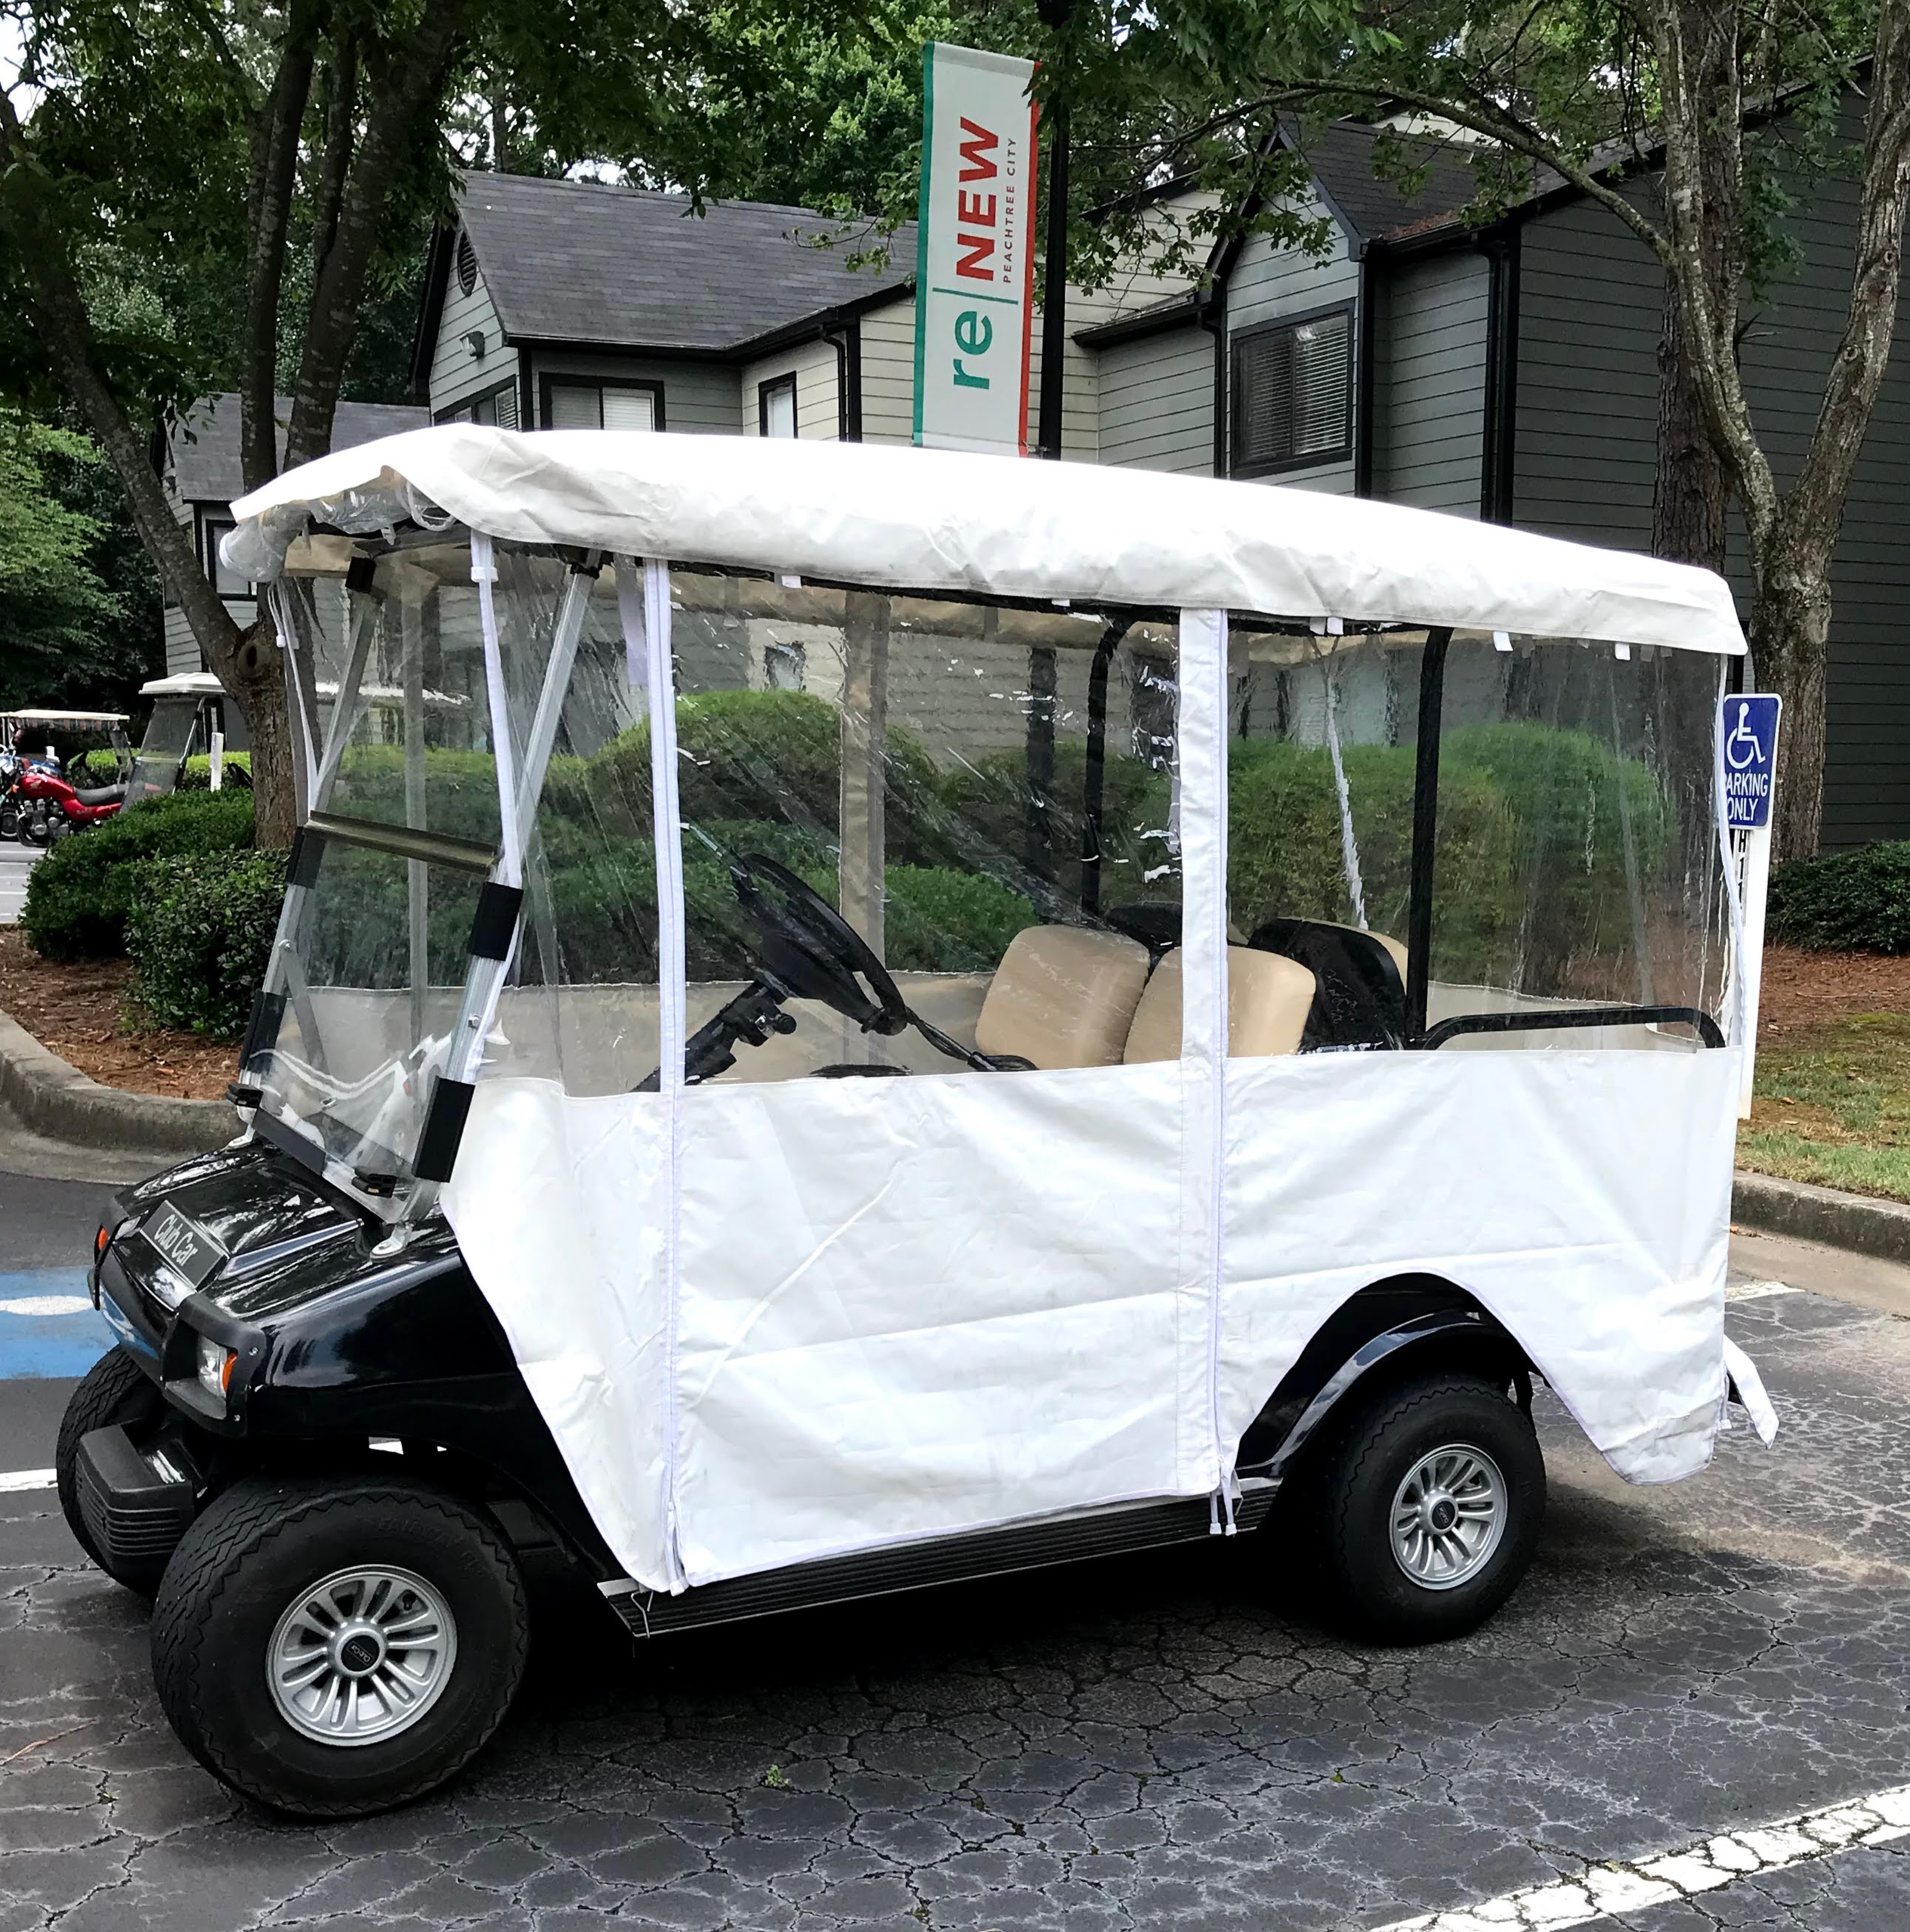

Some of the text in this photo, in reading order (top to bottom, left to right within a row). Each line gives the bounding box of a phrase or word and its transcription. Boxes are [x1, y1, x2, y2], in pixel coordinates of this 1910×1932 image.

[1002, 138, 1017, 283] PEACHTREE CITY
[953, 116, 998, 390] re NEW
[1726, 773, 1768, 797] ARKING
[1727, 798, 1758, 821] ONLY
[154, 1214, 198, 1266] Club Car
